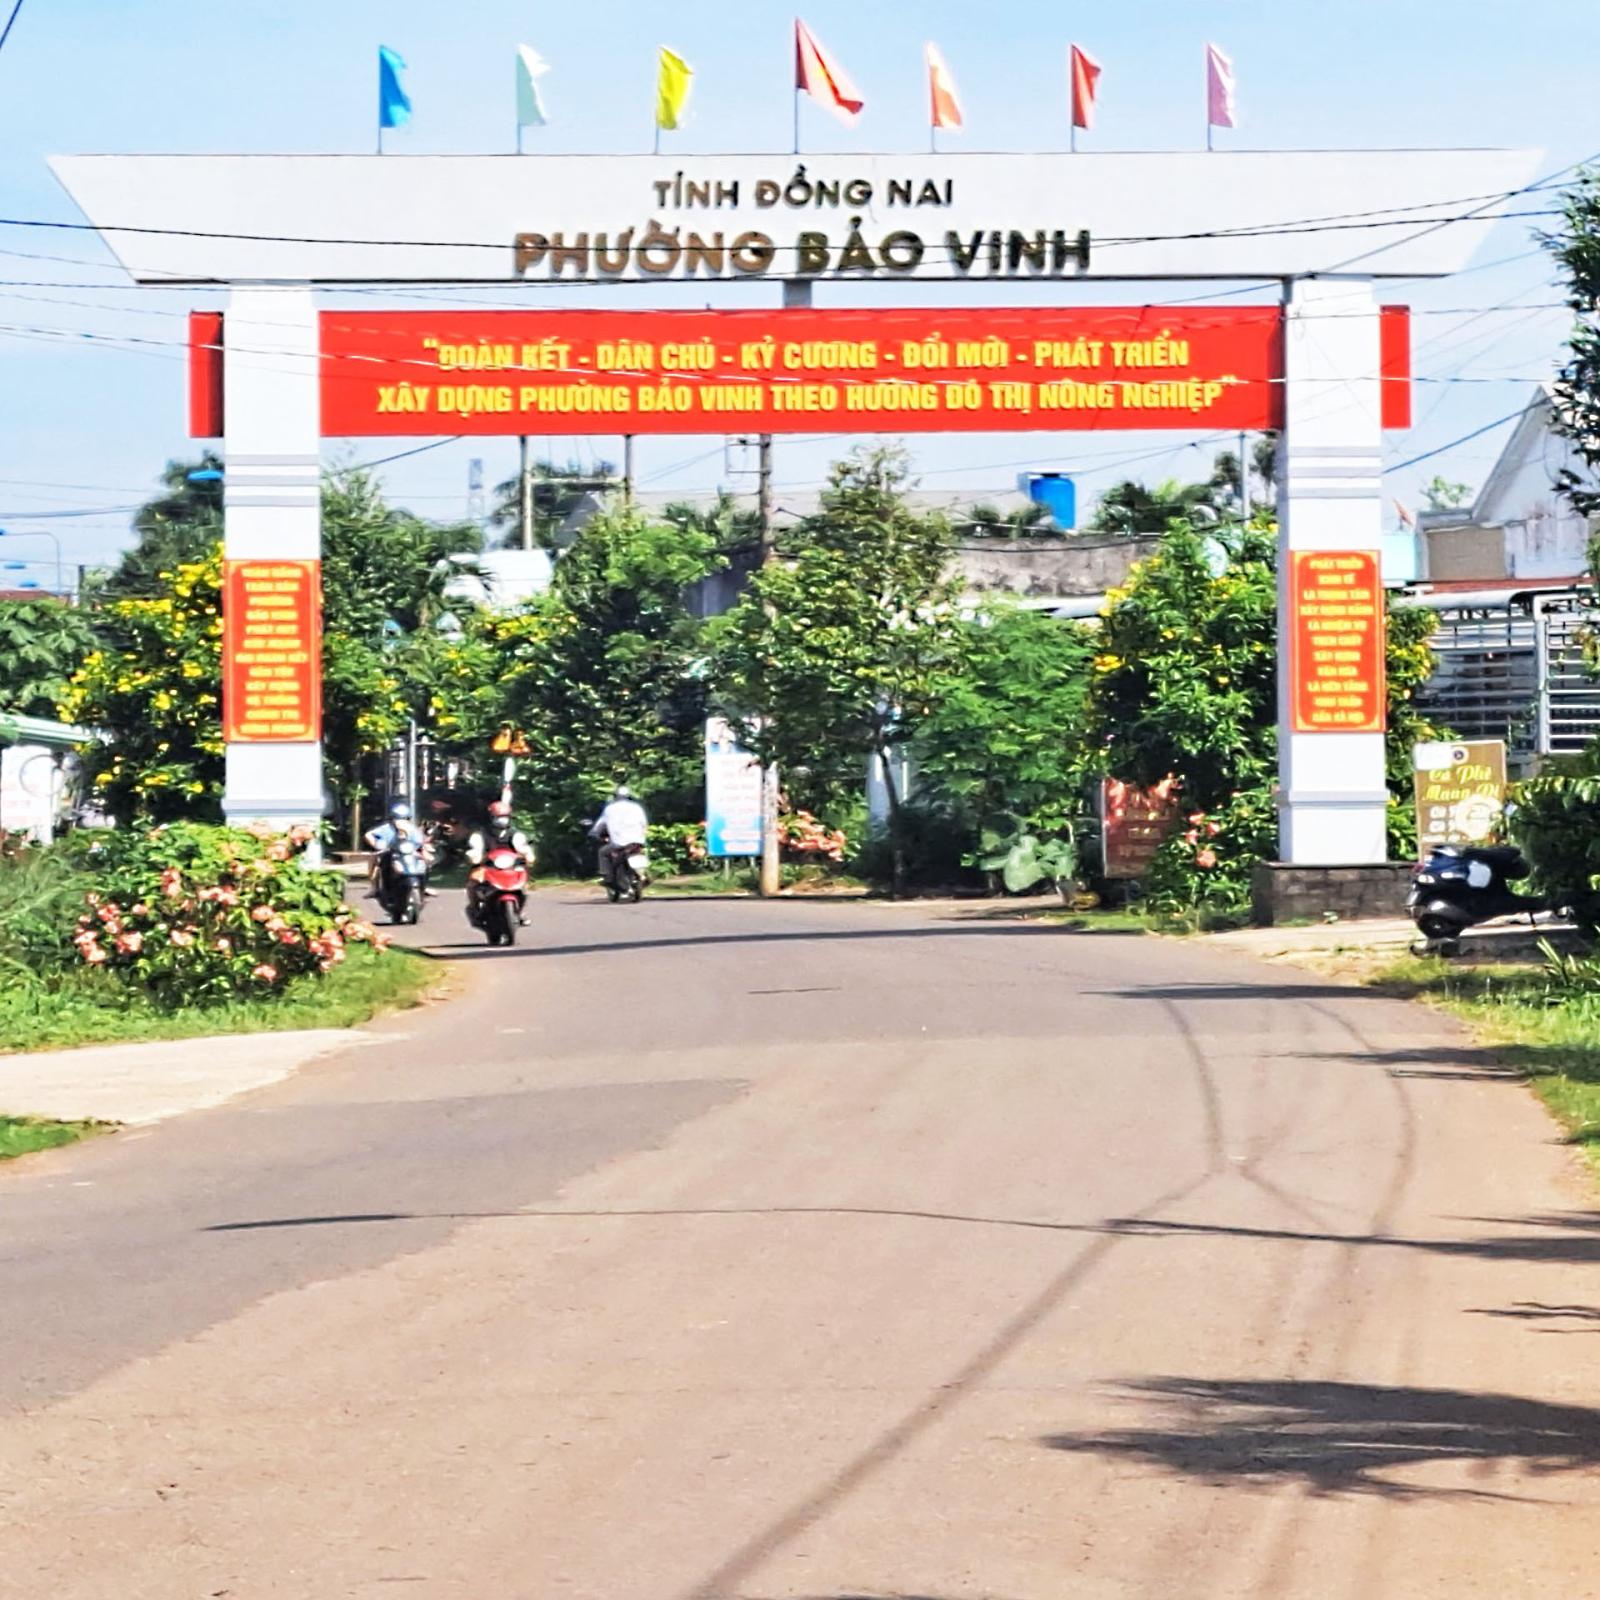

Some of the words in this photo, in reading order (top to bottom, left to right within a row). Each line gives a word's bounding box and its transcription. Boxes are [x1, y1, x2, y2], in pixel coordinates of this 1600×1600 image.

[653, 170, 738, 208] TỈNH
[755, 162, 873, 207] ĐỒNG
[888, 178, 953, 207] NAI
[514, 219, 775, 275] PHƯỜNG
[799, 215, 925, 275] BẢO
[945, 229, 1091, 272] VINH
[522, 336, 571, 370] KẾT
[597, 338, 653, 370] DÂN
[661, 336, 715, 370] CHỦ
[741, 335, 776, 369] KỶ
[784, 340, 877, 369] CƯƠNG
[903, 331, 948, 368] ĐỔI
[957, 335, 1008, 367] MỚI
[1035, 336, 1104, 367] PHÁT
[1111, 329, 1189, 367] TRIỂN
[378, 381, 430, 412] XÂY
[438, 384, 513, 418] DỰNG
[520, 379, 631, 412] PHƯỜNG
[638, 376, 692, 412] BẢO
[700, 385, 763, 411] VINH
[770, 385, 838, 411] THEO
[989, 383, 1031, 414] THỊ
[1040, 378, 1115, 410] NÔNG
